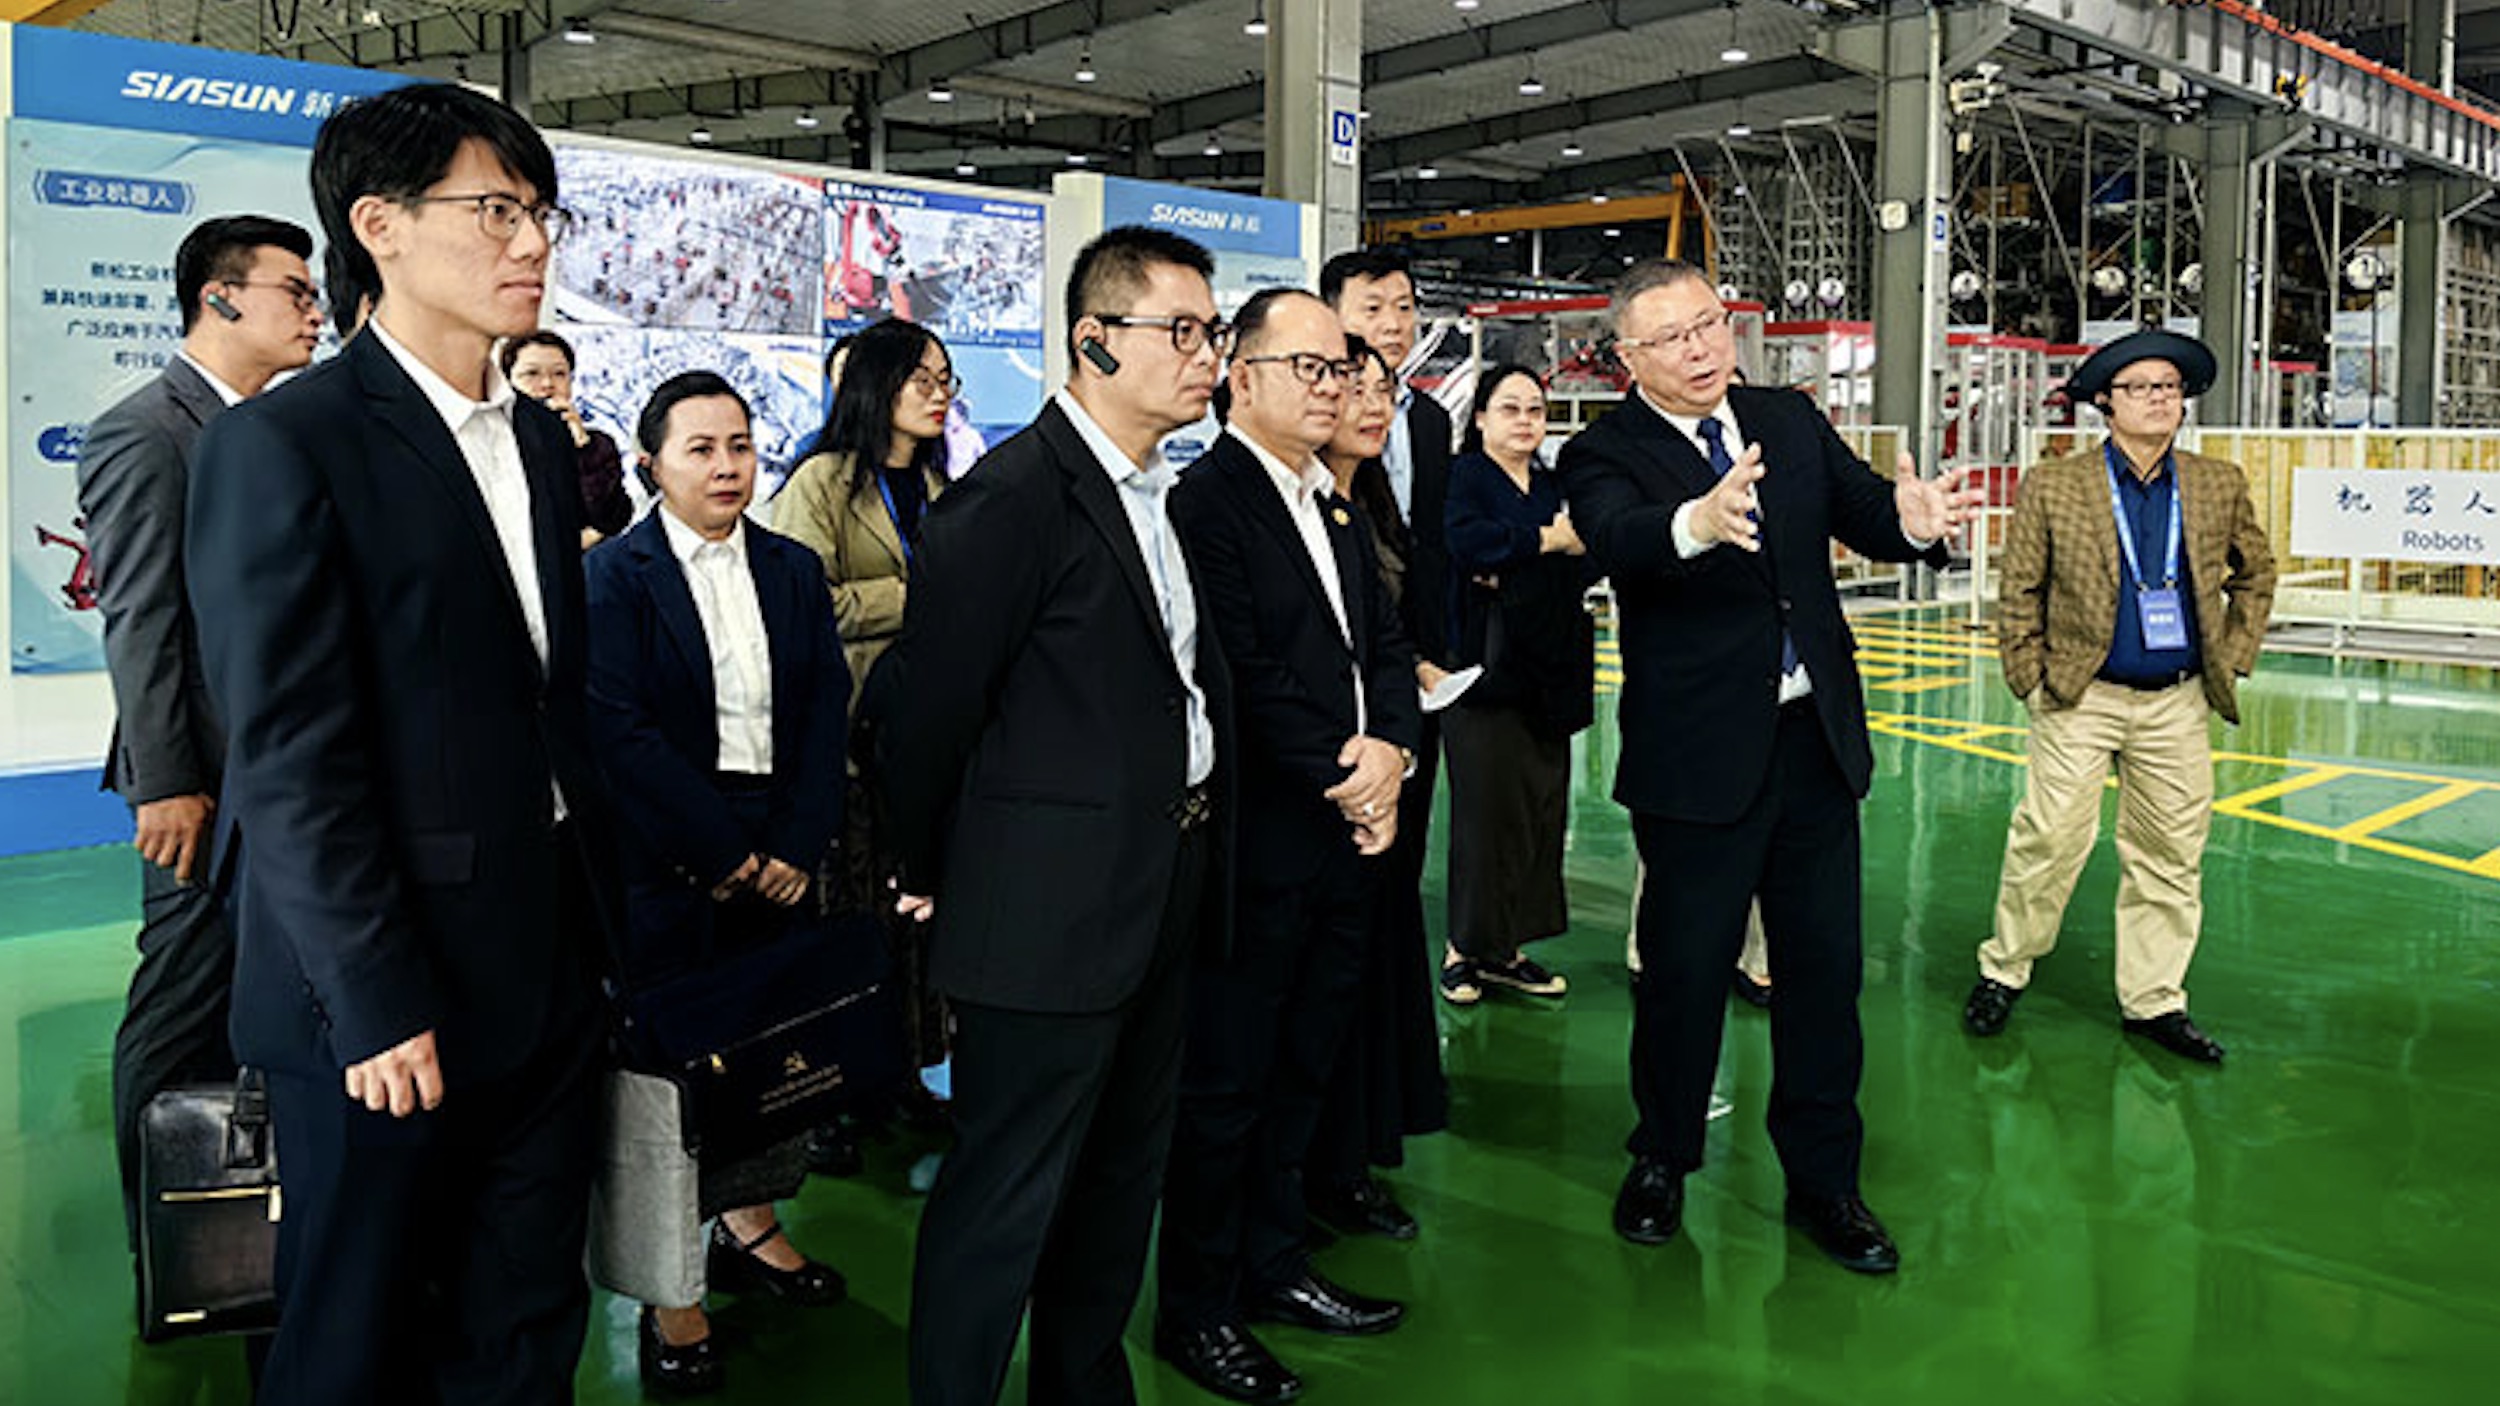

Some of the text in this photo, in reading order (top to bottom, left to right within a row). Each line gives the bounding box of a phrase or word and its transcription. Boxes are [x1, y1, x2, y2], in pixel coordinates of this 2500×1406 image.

[121, 71, 358, 119] SIASUN 新
[1338, 115, 1354, 142] D
[60, 179, 174, 209] 工业机器人
[1150, 203, 1229, 231] SIASUN
[2403, 530, 2484, 551] Robots
